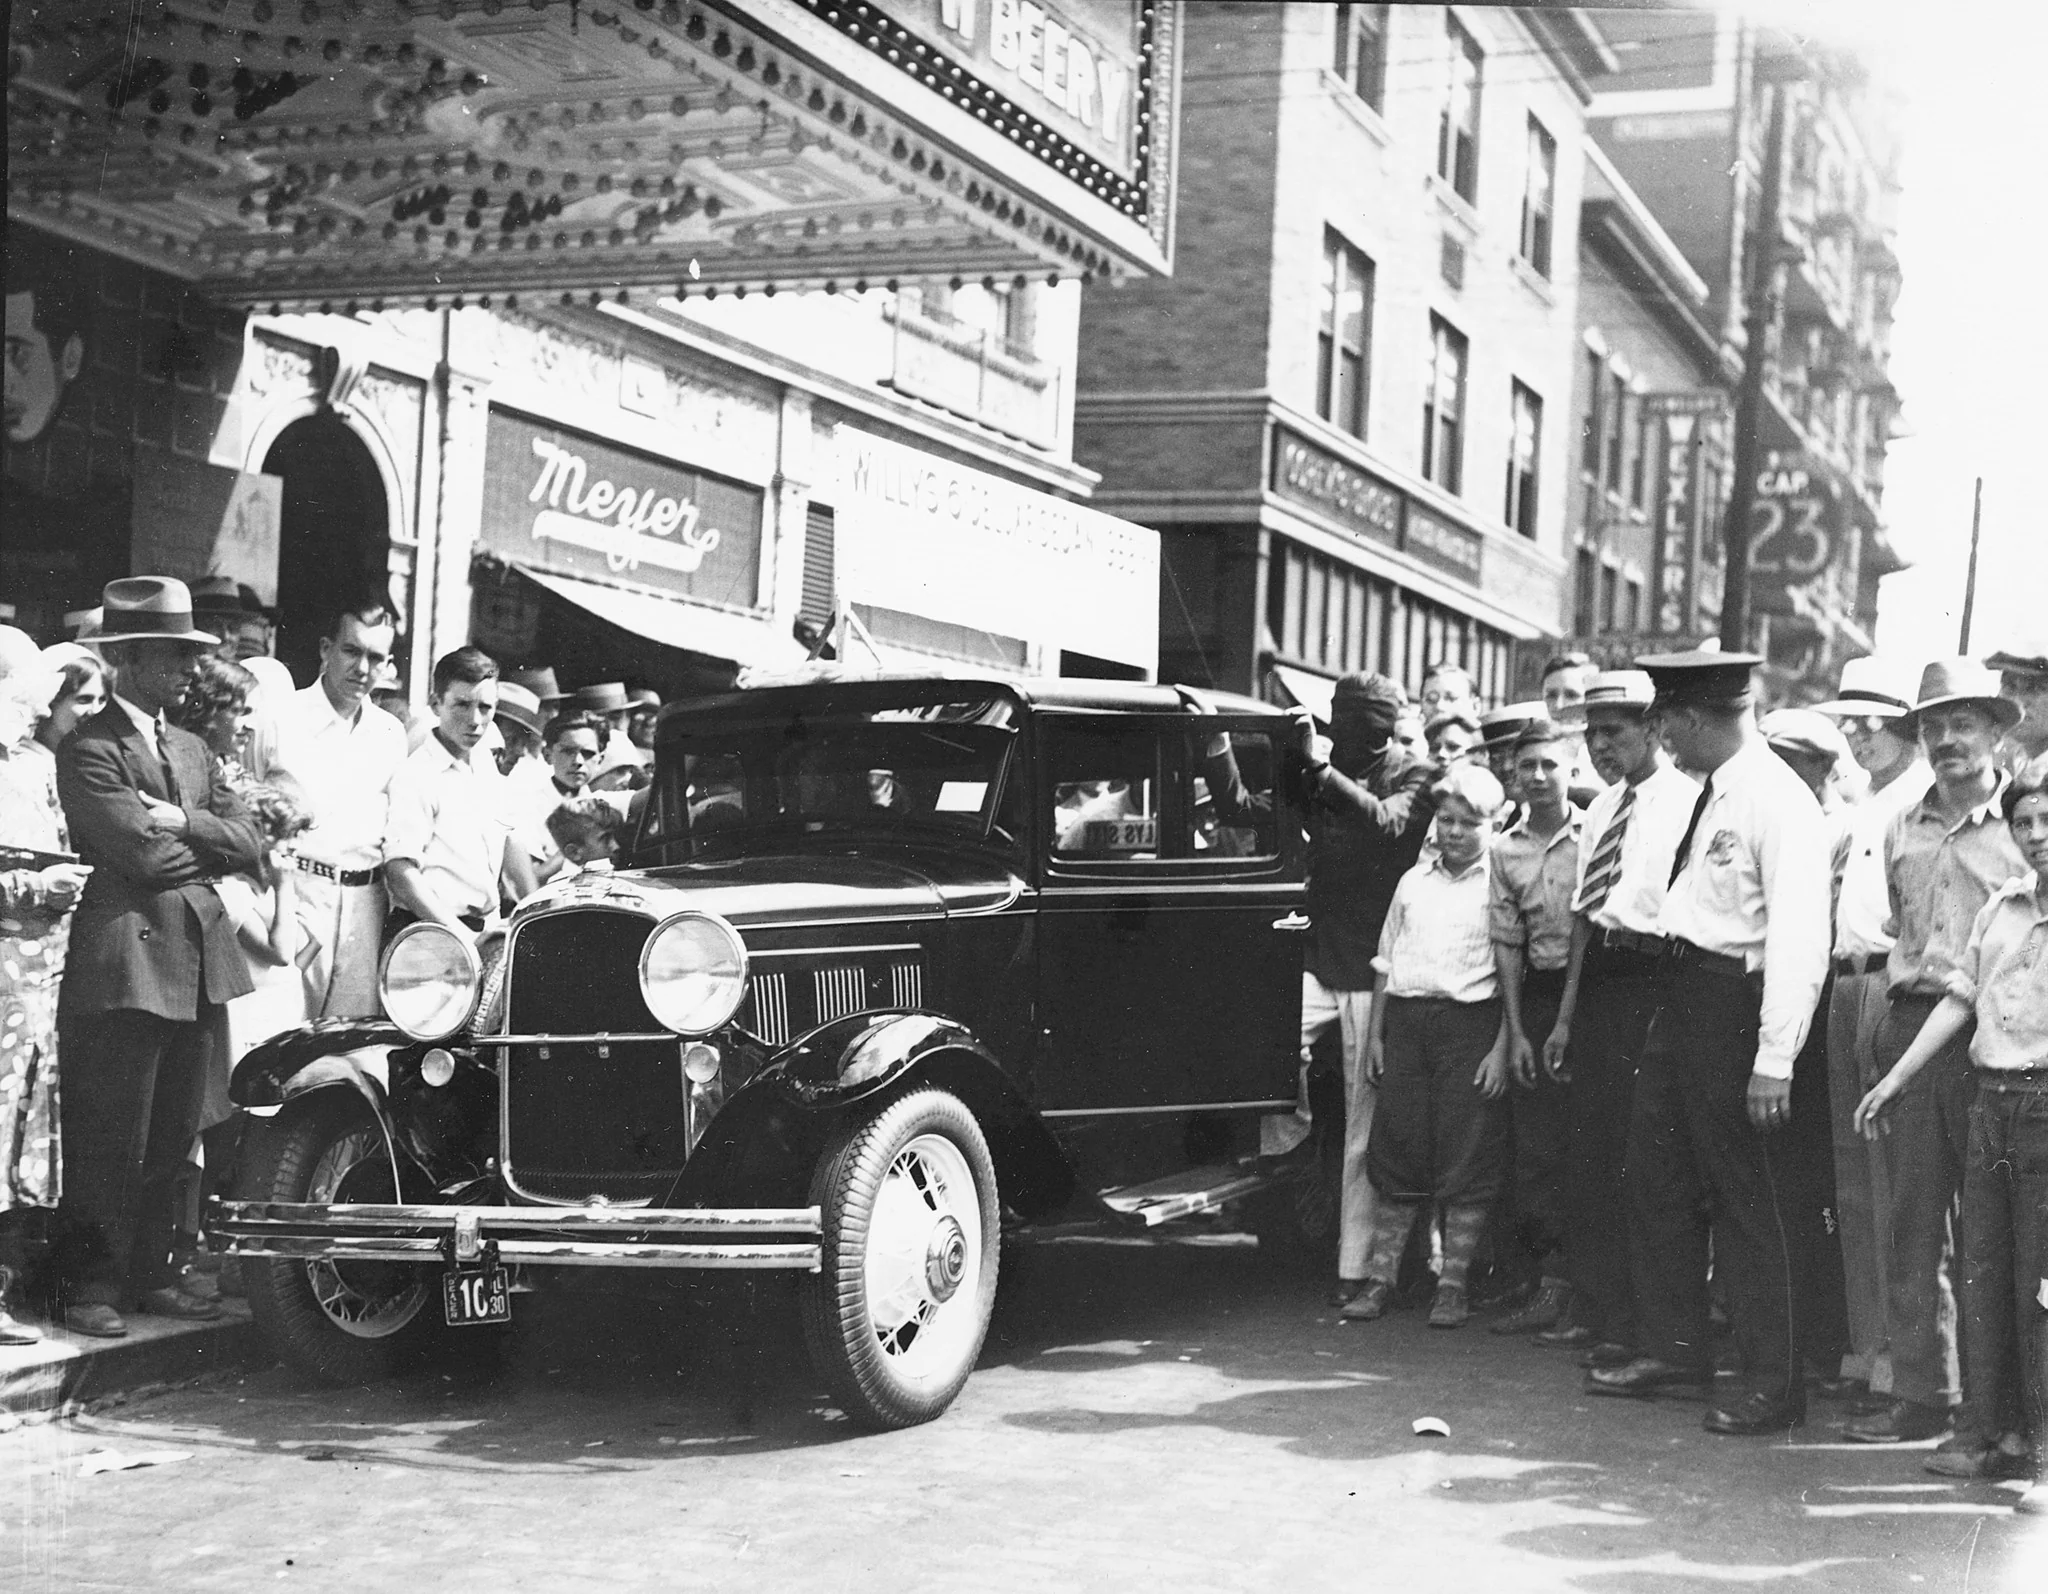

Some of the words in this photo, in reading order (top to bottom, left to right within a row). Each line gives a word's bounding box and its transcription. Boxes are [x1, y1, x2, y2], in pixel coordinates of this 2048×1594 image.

[991, 0, 1128, 143] BEERY
[529, 436, 720, 571] Meyer
[851, 449, 939, 514] WILLYS
[1757, 470, 1810, 495] CAP
[1747, 499, 1828, 572] 23
[489, 1295, 505, 1315] 30
